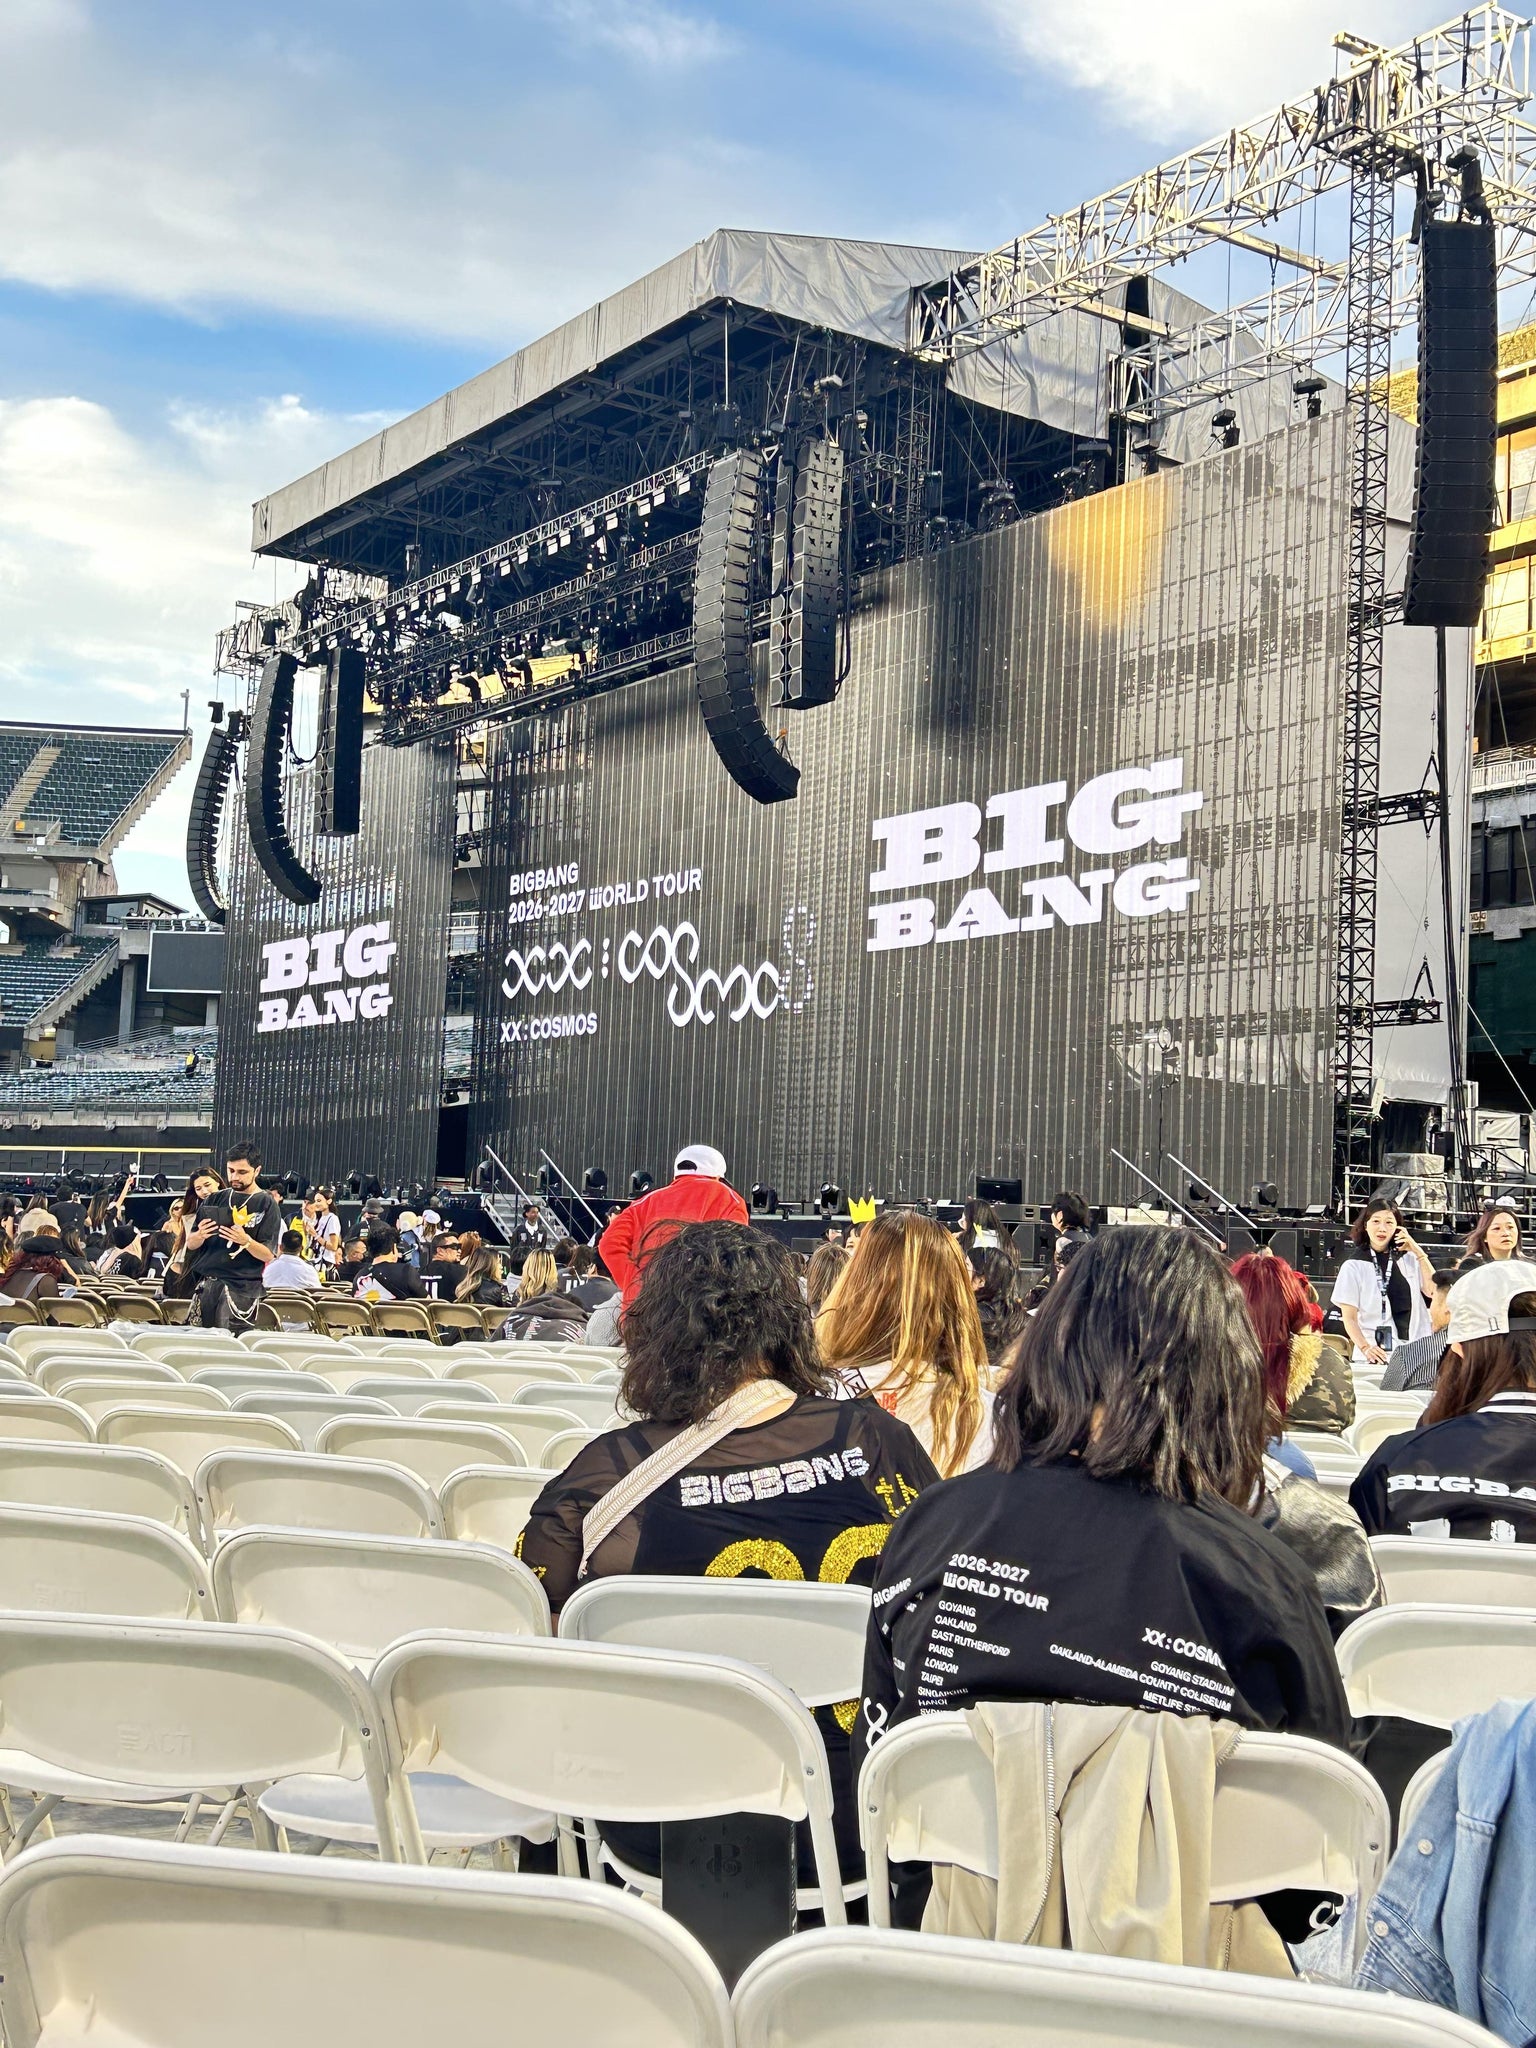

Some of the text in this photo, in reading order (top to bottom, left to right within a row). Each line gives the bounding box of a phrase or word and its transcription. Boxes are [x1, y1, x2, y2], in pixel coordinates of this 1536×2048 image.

[868, 756, 1204, 893] BIG
[508, 867, 702, 924] 2026-2027 WORLD TOUR
[509, 861, 579, 896] BIGBANG
[866, 856, 1200, 952] BANG
[260, 920, 397, 993] BIG
[257, 983, 394, 1033] BANG
[680, 1446, 870, 1507] BIGBANG
[948, 1553, 1030, 1583] 2026-2027
[938, 1600, 976, 1617] GOYANG
[942, 1571, 1050, 1612] WORLD TOUR
[934, 1614, 977, 1633] OAKLAND
[928, 1642, 955, 1658] PARIS
[931, 1629, 1011, 1657] EAST RUTHERFORD
[920, 1671, 944, 1686] TAIPEI
[924, 1656, 959, 1675] LONDON
[1049, 1644, 1139, 1682] OAKLAND-ALAMEDA
[1139, 1673, 1180, 1693] COUNTY
[1180, 1686, 1232, 1712] COLISEUM
[1150, 1660, 1235, 1697] GOYANG STADIUM
[1142, 1690, 1183, 1711] METLIFE
